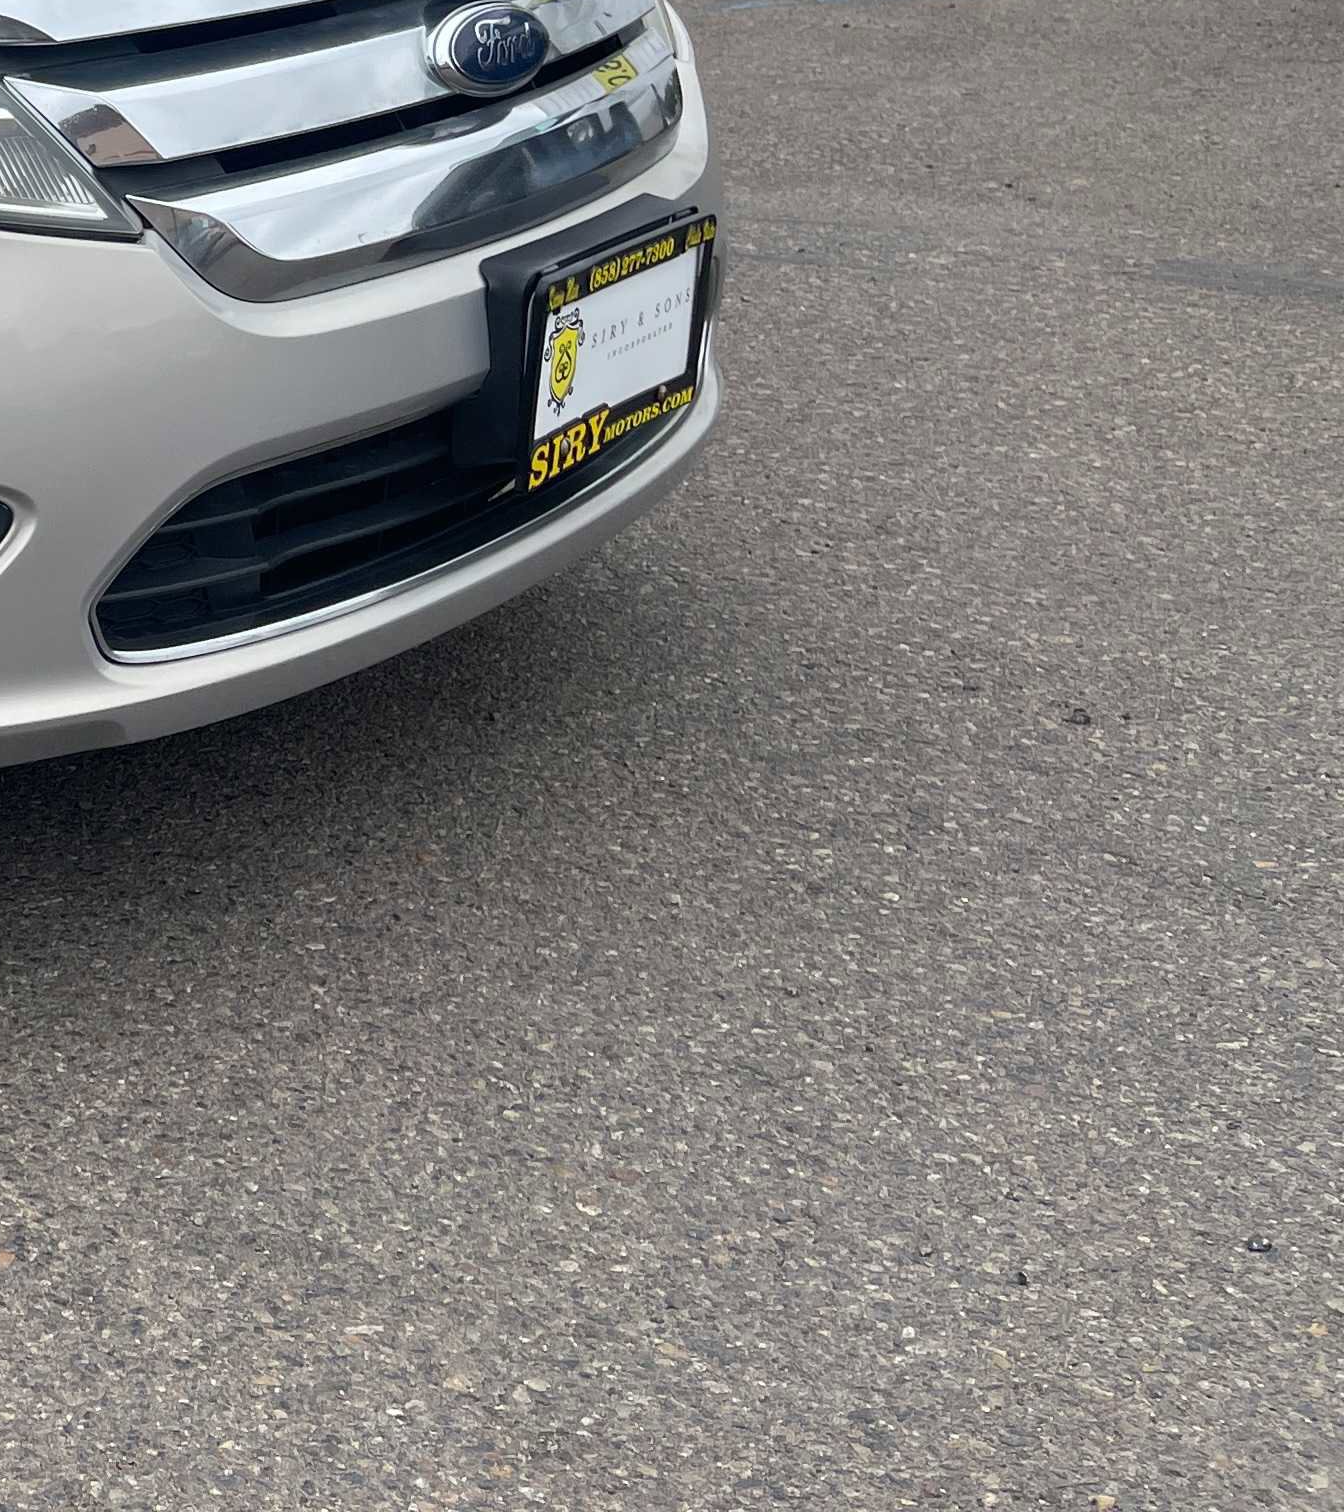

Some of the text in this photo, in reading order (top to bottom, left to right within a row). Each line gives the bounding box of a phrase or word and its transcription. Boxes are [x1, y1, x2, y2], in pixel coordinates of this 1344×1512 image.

[474, 15, 536, 72] Ford
[591, 317, 628, 350] SIRY
[655, 288, 692, 321] SONS
